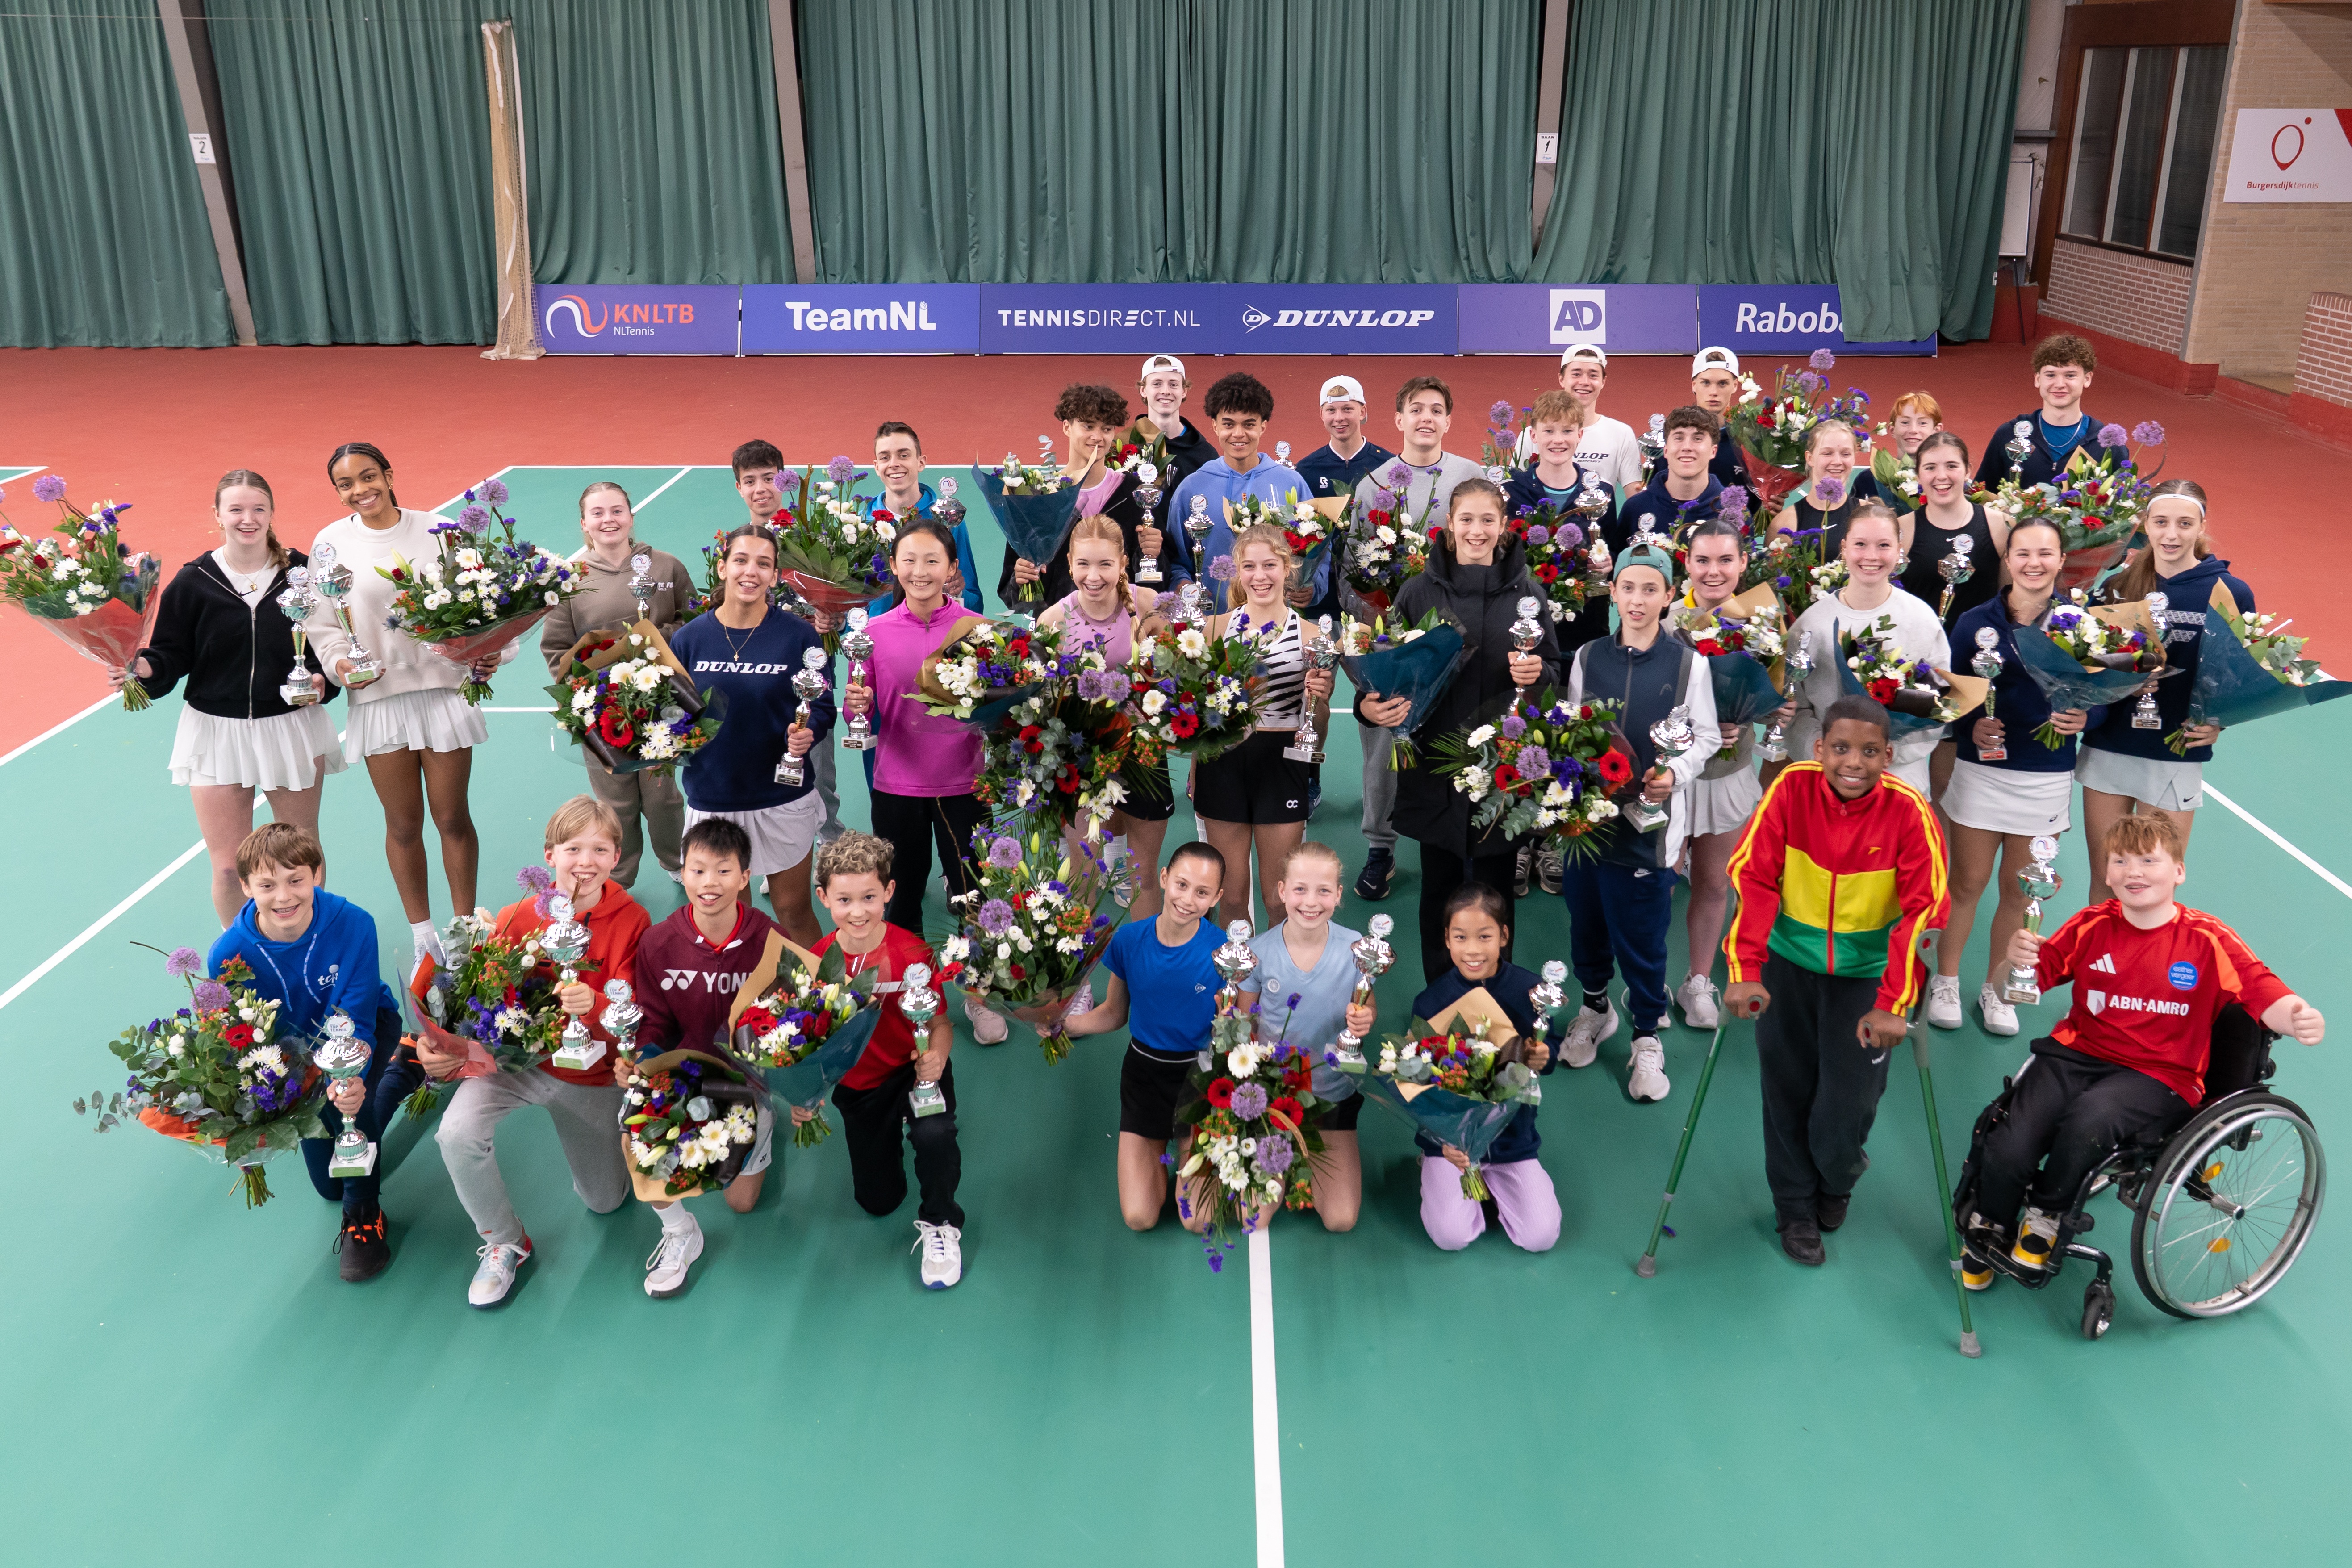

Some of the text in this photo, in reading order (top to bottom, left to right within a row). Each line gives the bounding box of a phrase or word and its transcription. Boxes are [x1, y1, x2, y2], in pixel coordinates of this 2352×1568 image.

[199, 141, 205, 153] 2
[1545, 140, 1550, 153] 1
[614, 304, 694, 324] KNLTB
[785, 301, 936, 331] TeamNL
[998, 309, 1200, 326] TENNISDIRECT.NL
[1273, 310, 1435, 327] DUNLOP
[1554, 301, 1602, 331] AD
[1735, 302, 1843, 333] Rabob
[614, 326, 655, 335] NLTennis
[693, 661, 788, 674] DUNLOP
[702, 972, 753, 994] YON
